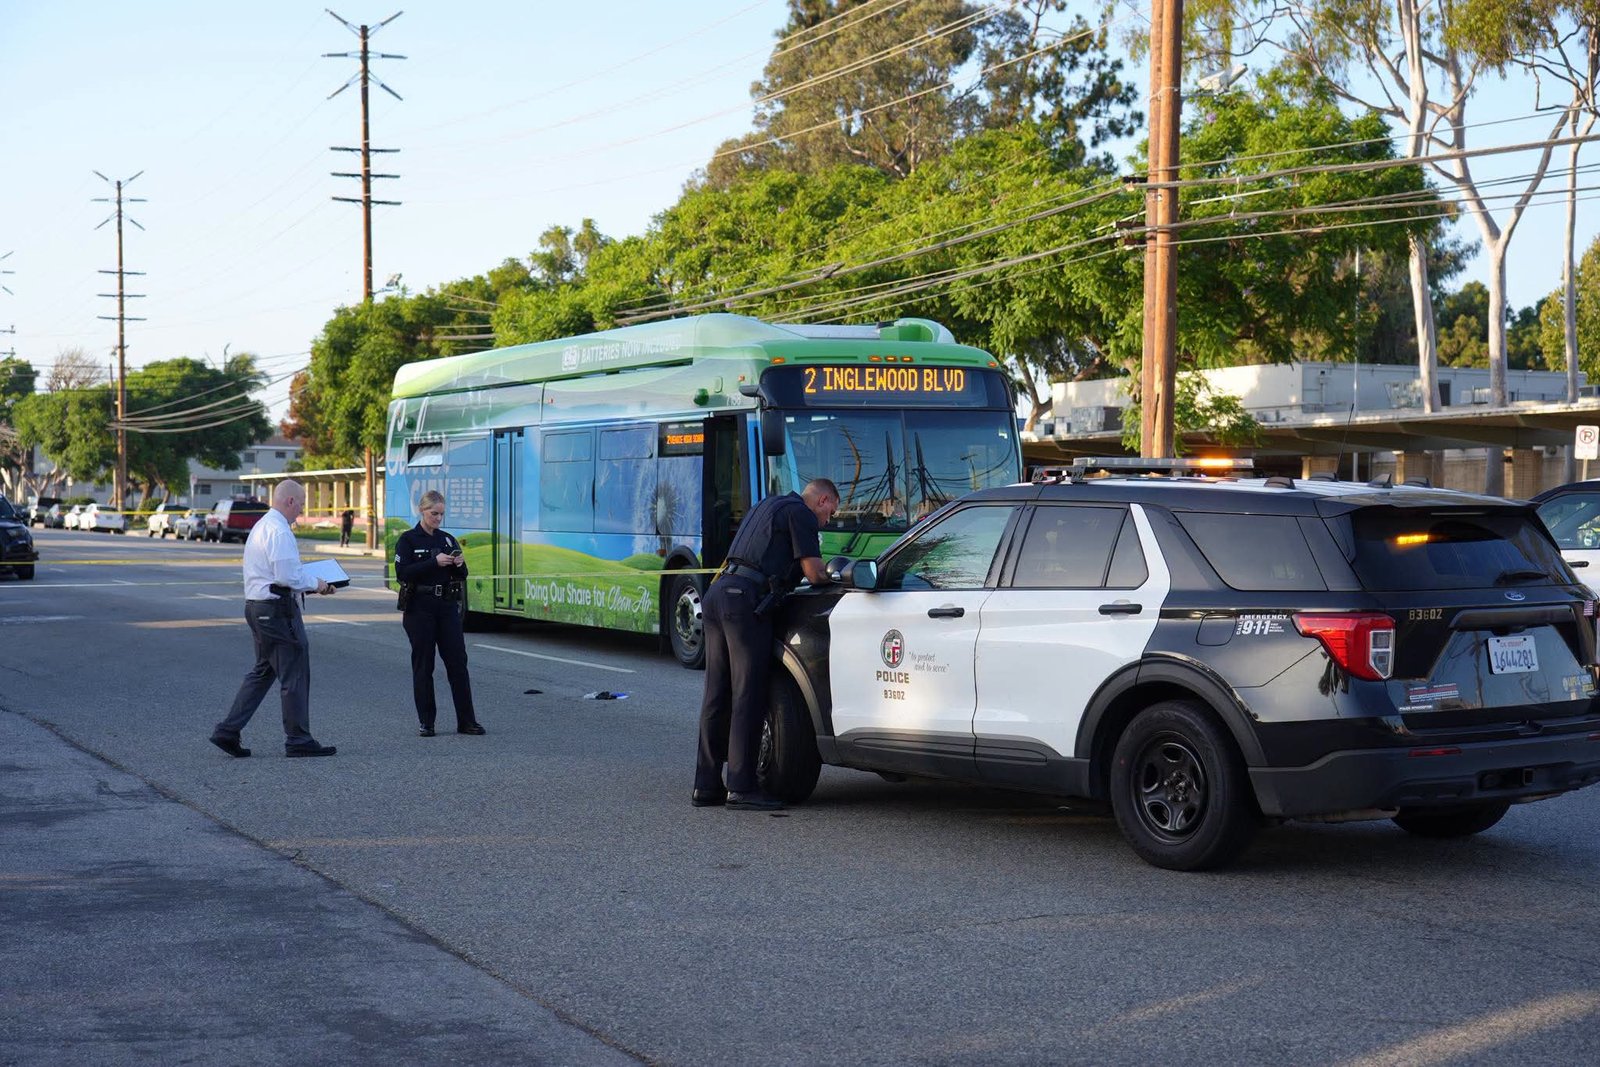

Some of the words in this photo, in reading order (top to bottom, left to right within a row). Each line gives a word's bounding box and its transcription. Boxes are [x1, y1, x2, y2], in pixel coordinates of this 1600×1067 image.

[580, 343, 620, 364] BATTERIES
[621, 339, 641, 358] NOW
[804, 367, 817, 394] 2
[822, 367, 918, 391] INGLEWOOD
[923, 368, 964, 392] BLVD
[525, 579, 548, 606] Doing
[550, 581, 565, 603] Our
[567, 583, 591, 606] Share
[593, 585, 605, 607] for
[608, 586, 632, 612] Clean
[1409, 609, 1442, 620] 83602
[1494, 649, 1535, 669] 1644281
[876, 670, 909, 683] POLICE
[884, 689, 905, 700] 83602
